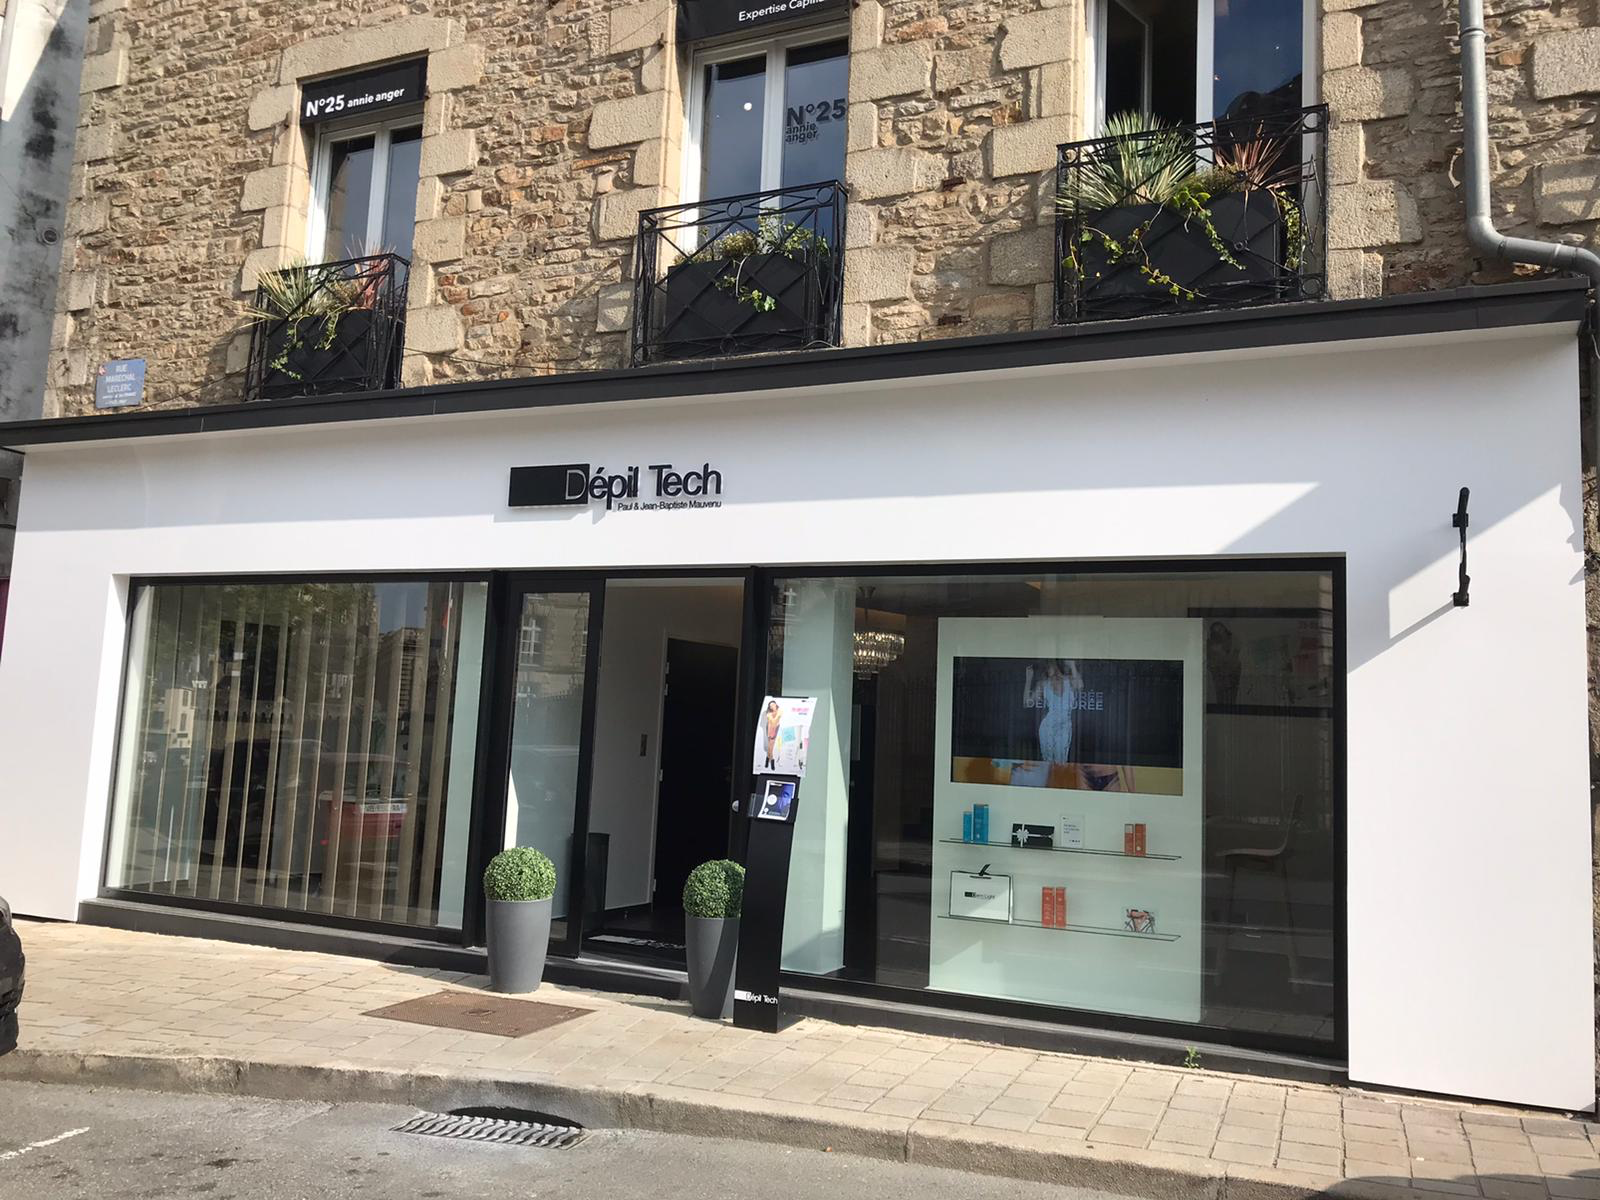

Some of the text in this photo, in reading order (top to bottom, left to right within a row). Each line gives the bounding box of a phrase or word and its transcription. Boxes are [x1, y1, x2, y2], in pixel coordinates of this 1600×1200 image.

[738, 4, 787, 21] Expertise
[306, 88, 405, 117] N°25 annie anger
[786, 98, 847, 127] N°25
[785, 122, 817, 134] annie
[785, 130, 818, 143] anger
[115, 363, 128, 373] RUE
[106, 383, 132, 393] LECLERC
[565, 462, 722, 510] Dépil Tech
[617, 500, 722, 511] Paul & Jean-Baptiste Mauvenu
[745, 992, 778, 1004] Dépil Tech
